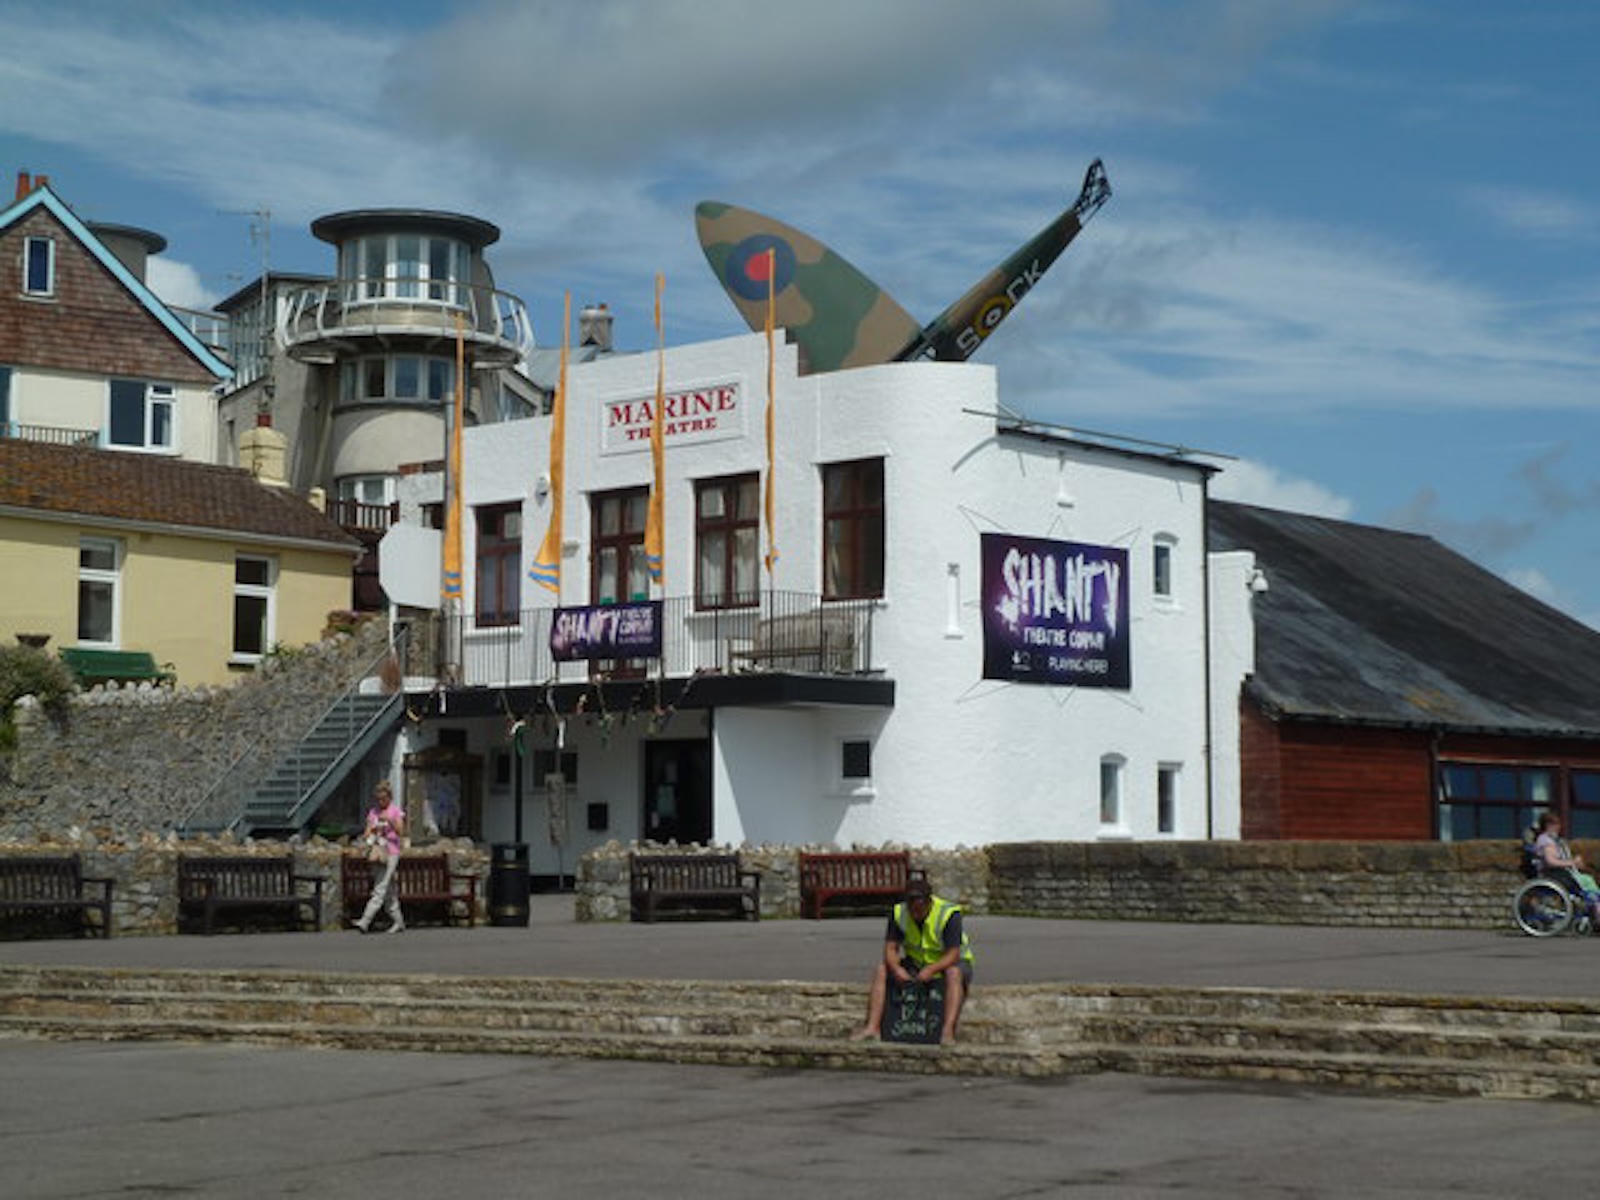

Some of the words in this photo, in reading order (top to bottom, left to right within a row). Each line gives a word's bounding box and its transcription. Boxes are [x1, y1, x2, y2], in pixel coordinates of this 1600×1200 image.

[609, 387, 736, 427] MARINE
[625, 417, 717, 440] THATRE
[998, 547, 1119, 637] SHANTY
[557, 608, 620, 645] SHANTY
